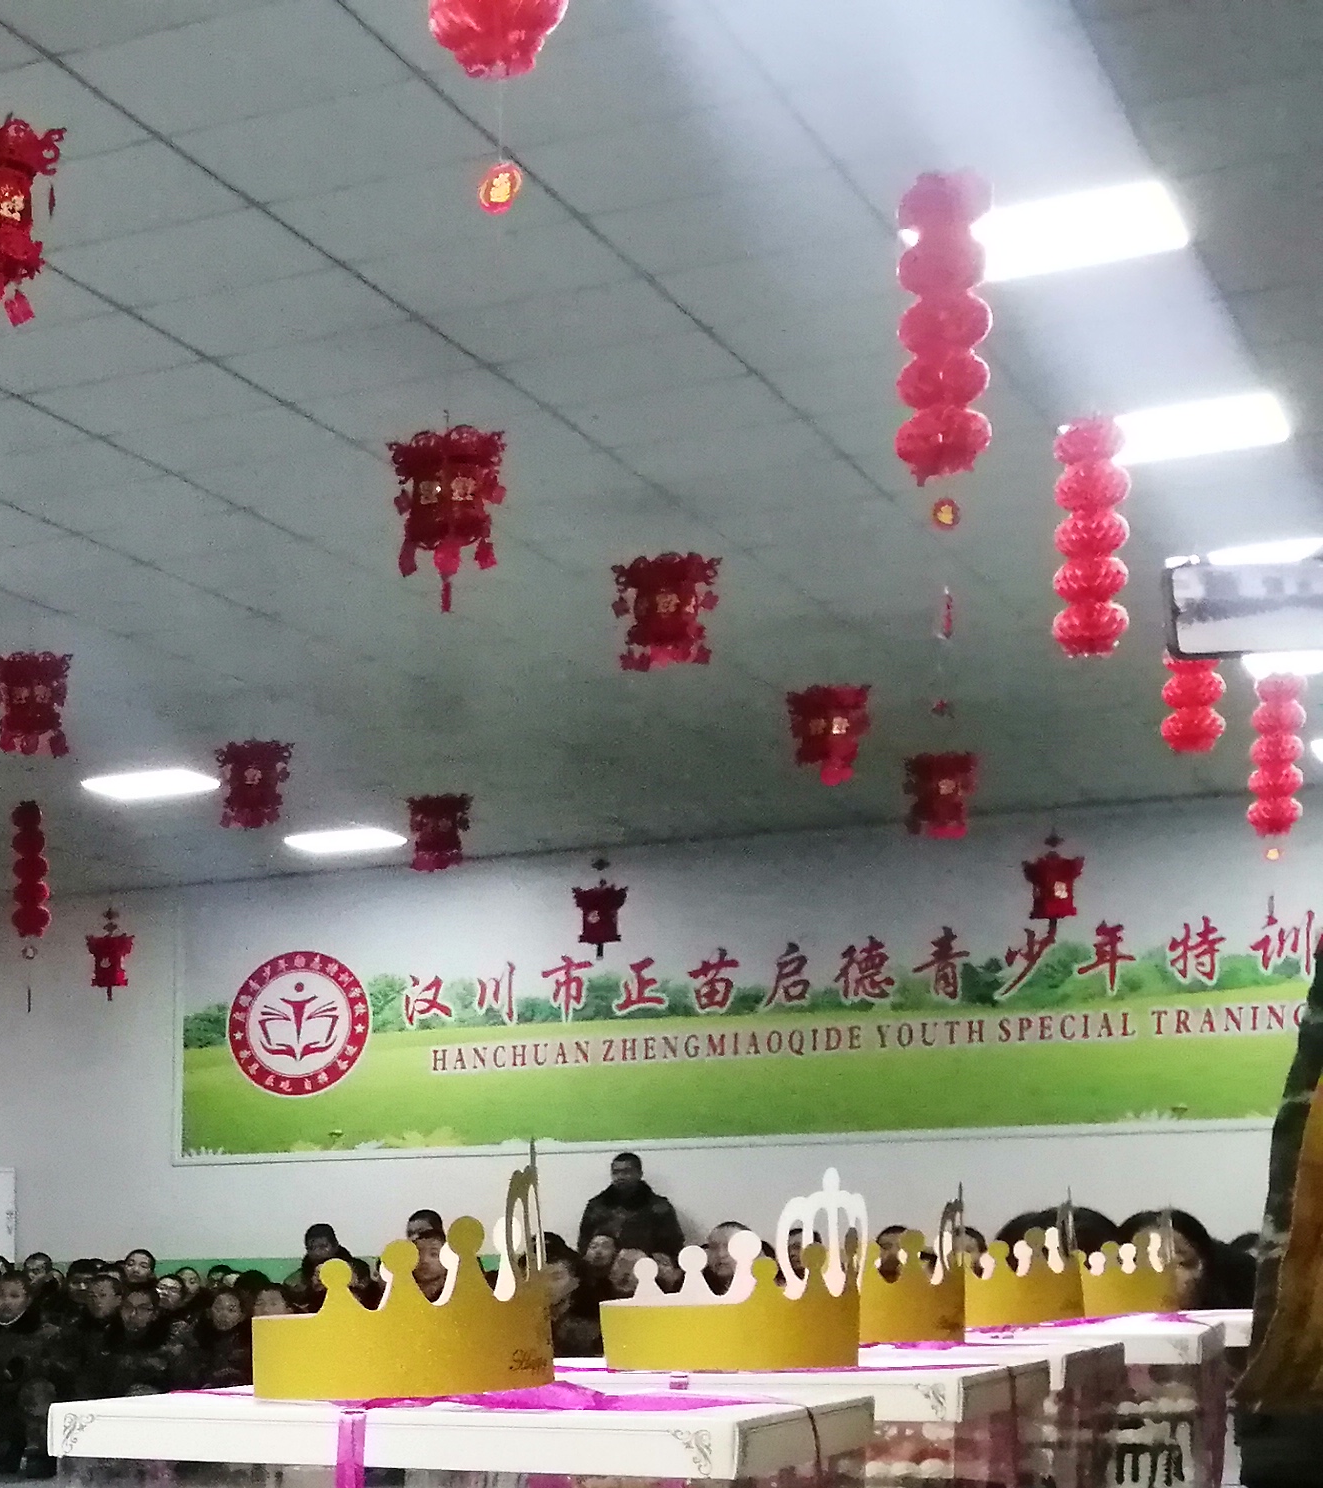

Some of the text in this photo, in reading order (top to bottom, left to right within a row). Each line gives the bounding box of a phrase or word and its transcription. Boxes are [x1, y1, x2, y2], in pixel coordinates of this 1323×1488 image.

[431, 1040, 590, 1072] HANCHUAN
[601, 1024, 861, 1062] ZHENGMIAOQIDE
[876, 1018, 985, 1048] YOUTH
[998, 1011, 1136, 1043] SPECIAL
